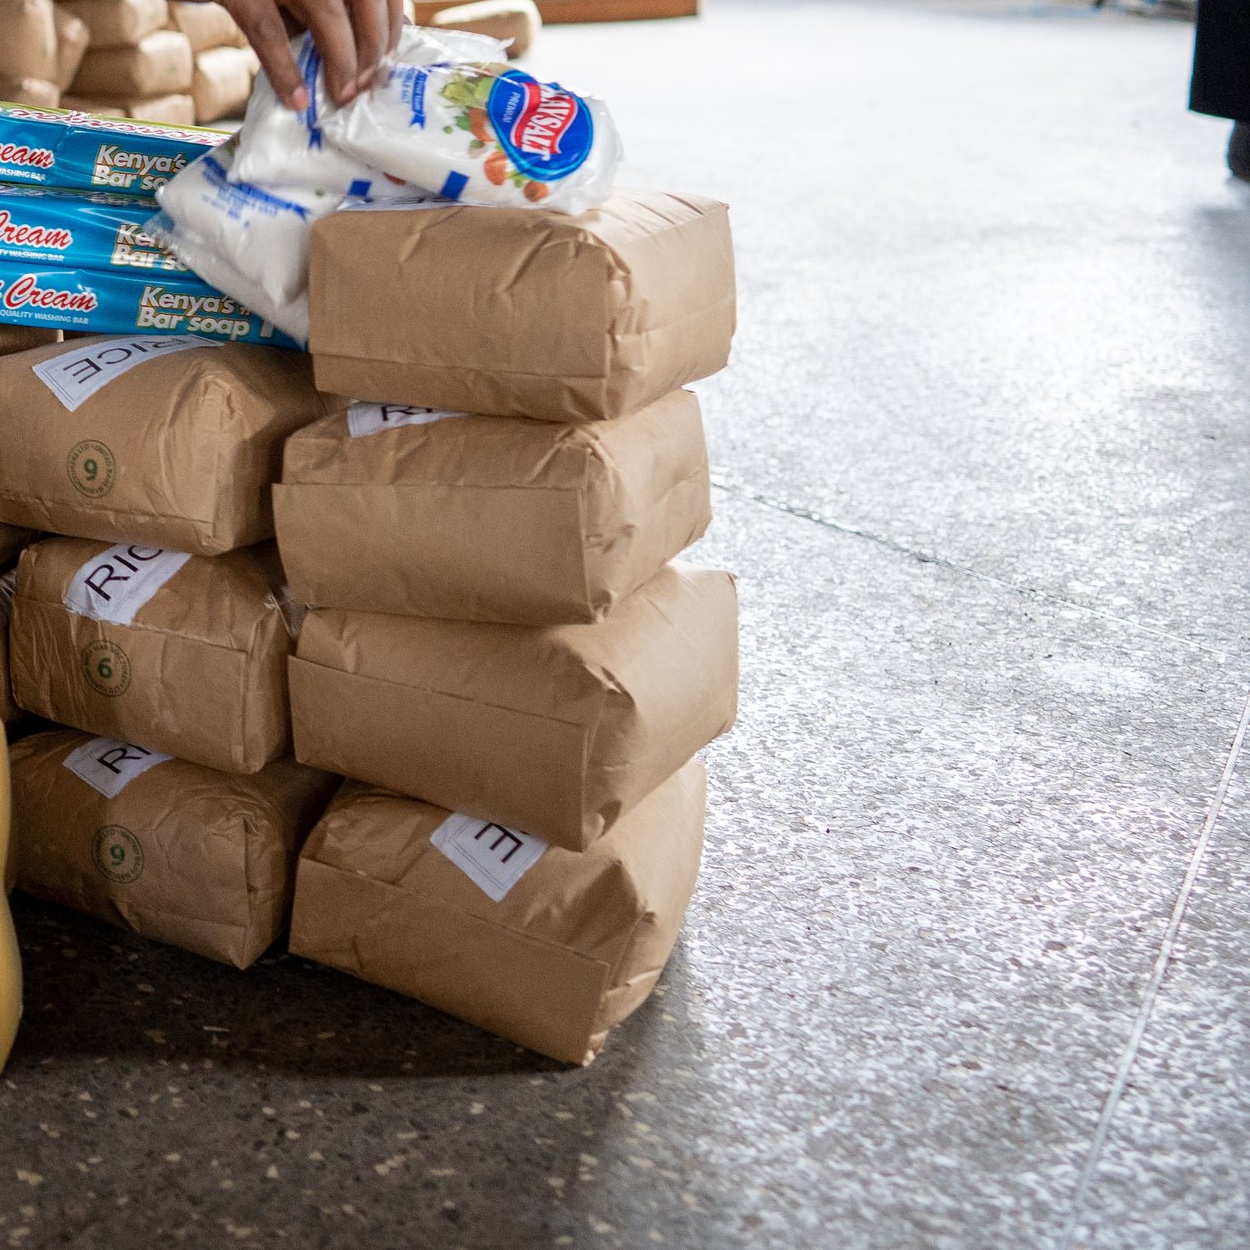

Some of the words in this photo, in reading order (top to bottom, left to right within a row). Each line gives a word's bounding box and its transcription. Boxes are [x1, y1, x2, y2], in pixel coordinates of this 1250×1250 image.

[96, 144, 187, 176] Kenya's
[92, 164, 138, 188] Bar
[141, 173, 175, 191] so
[111, 244, 160, 268] Bar
[3, 273, 99, 313] Cream
[139, 286, 237, 317] Kenya's
[0, 308, 34, 320] QUALITY
[33, 311, 73, 324] WASHING
[73, 315, 90, 326] BAR
[136, 305, 183, 330] Bar
[186, 314, 252, 340] soap
[84, 545, 163, 602] RIC
[96, 743, 152, 775] RI
